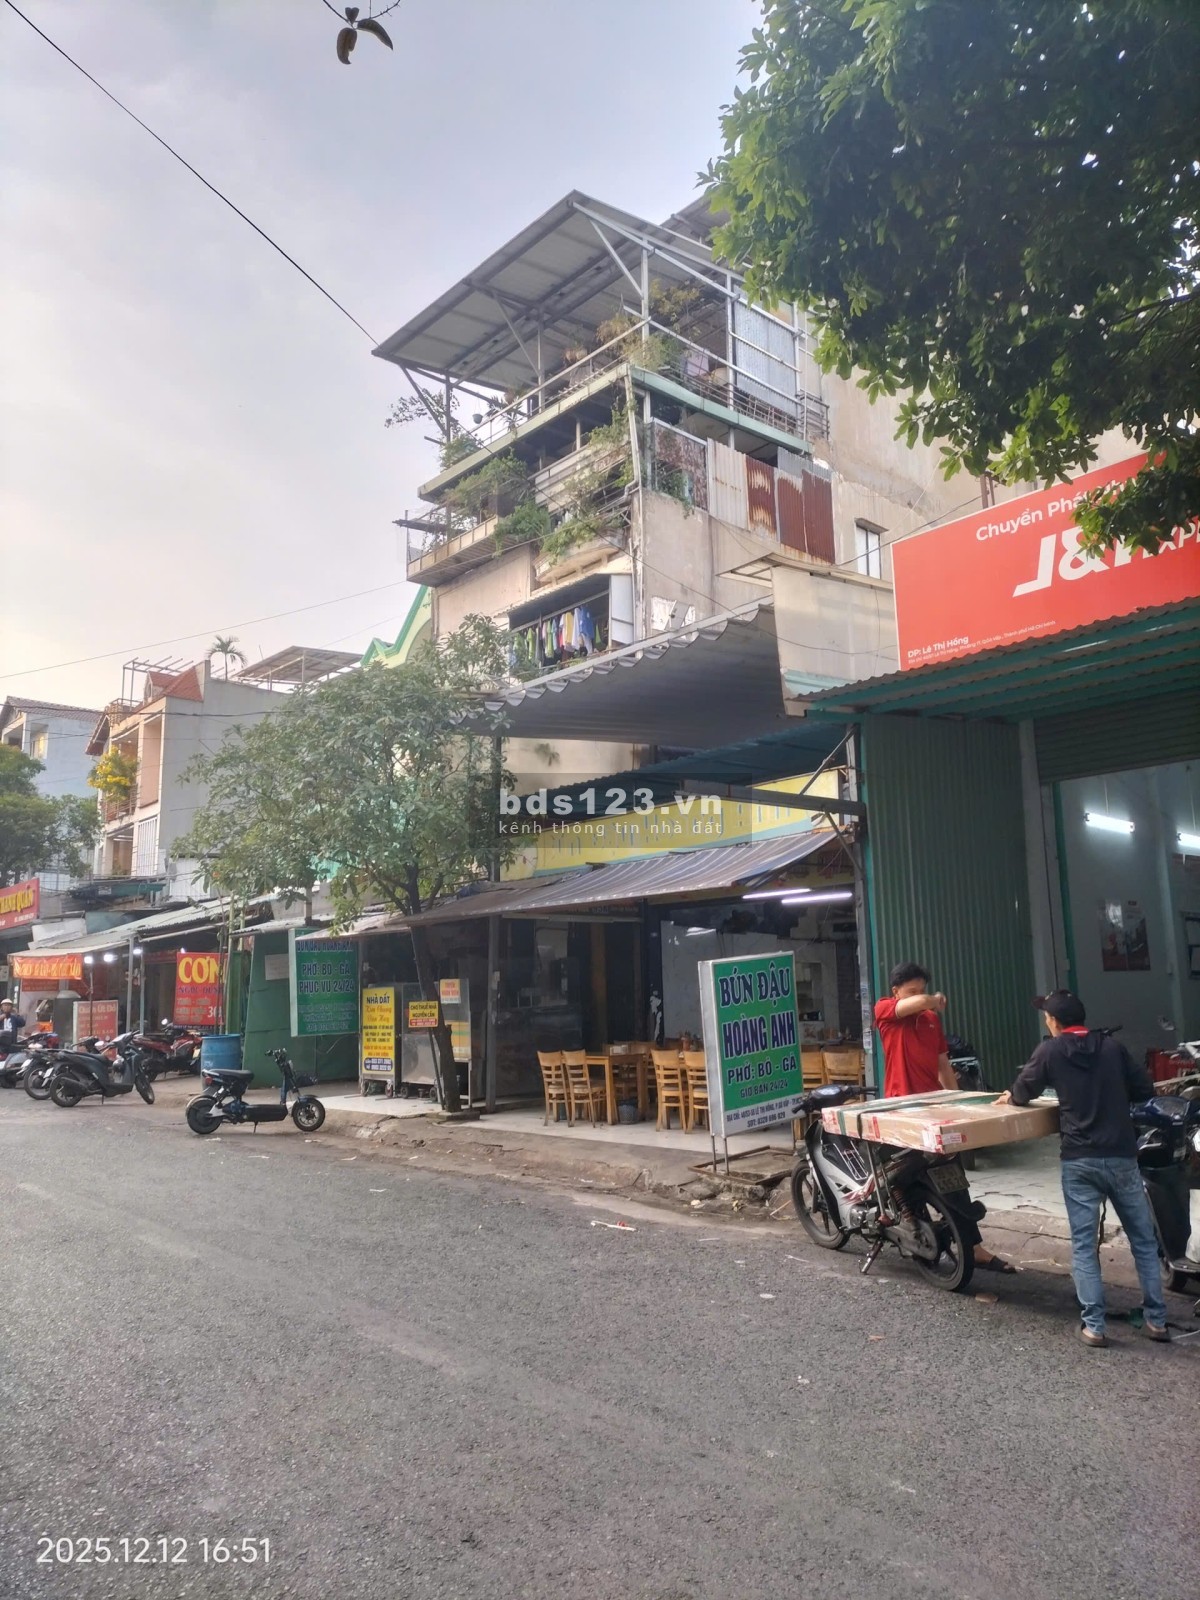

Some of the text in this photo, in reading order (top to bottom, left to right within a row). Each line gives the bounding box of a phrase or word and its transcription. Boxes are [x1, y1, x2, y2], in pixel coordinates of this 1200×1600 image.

[933, 641, 946, 652] Thị
[718, 960, 791, 1008] BÚN ĐẬU
[366, 992, 390, 1004] NHÀ ĐẤT
[722, 1010, 796, 1059] HOÀNG ANH
[782, 1052, 797, 1073] GÀ
